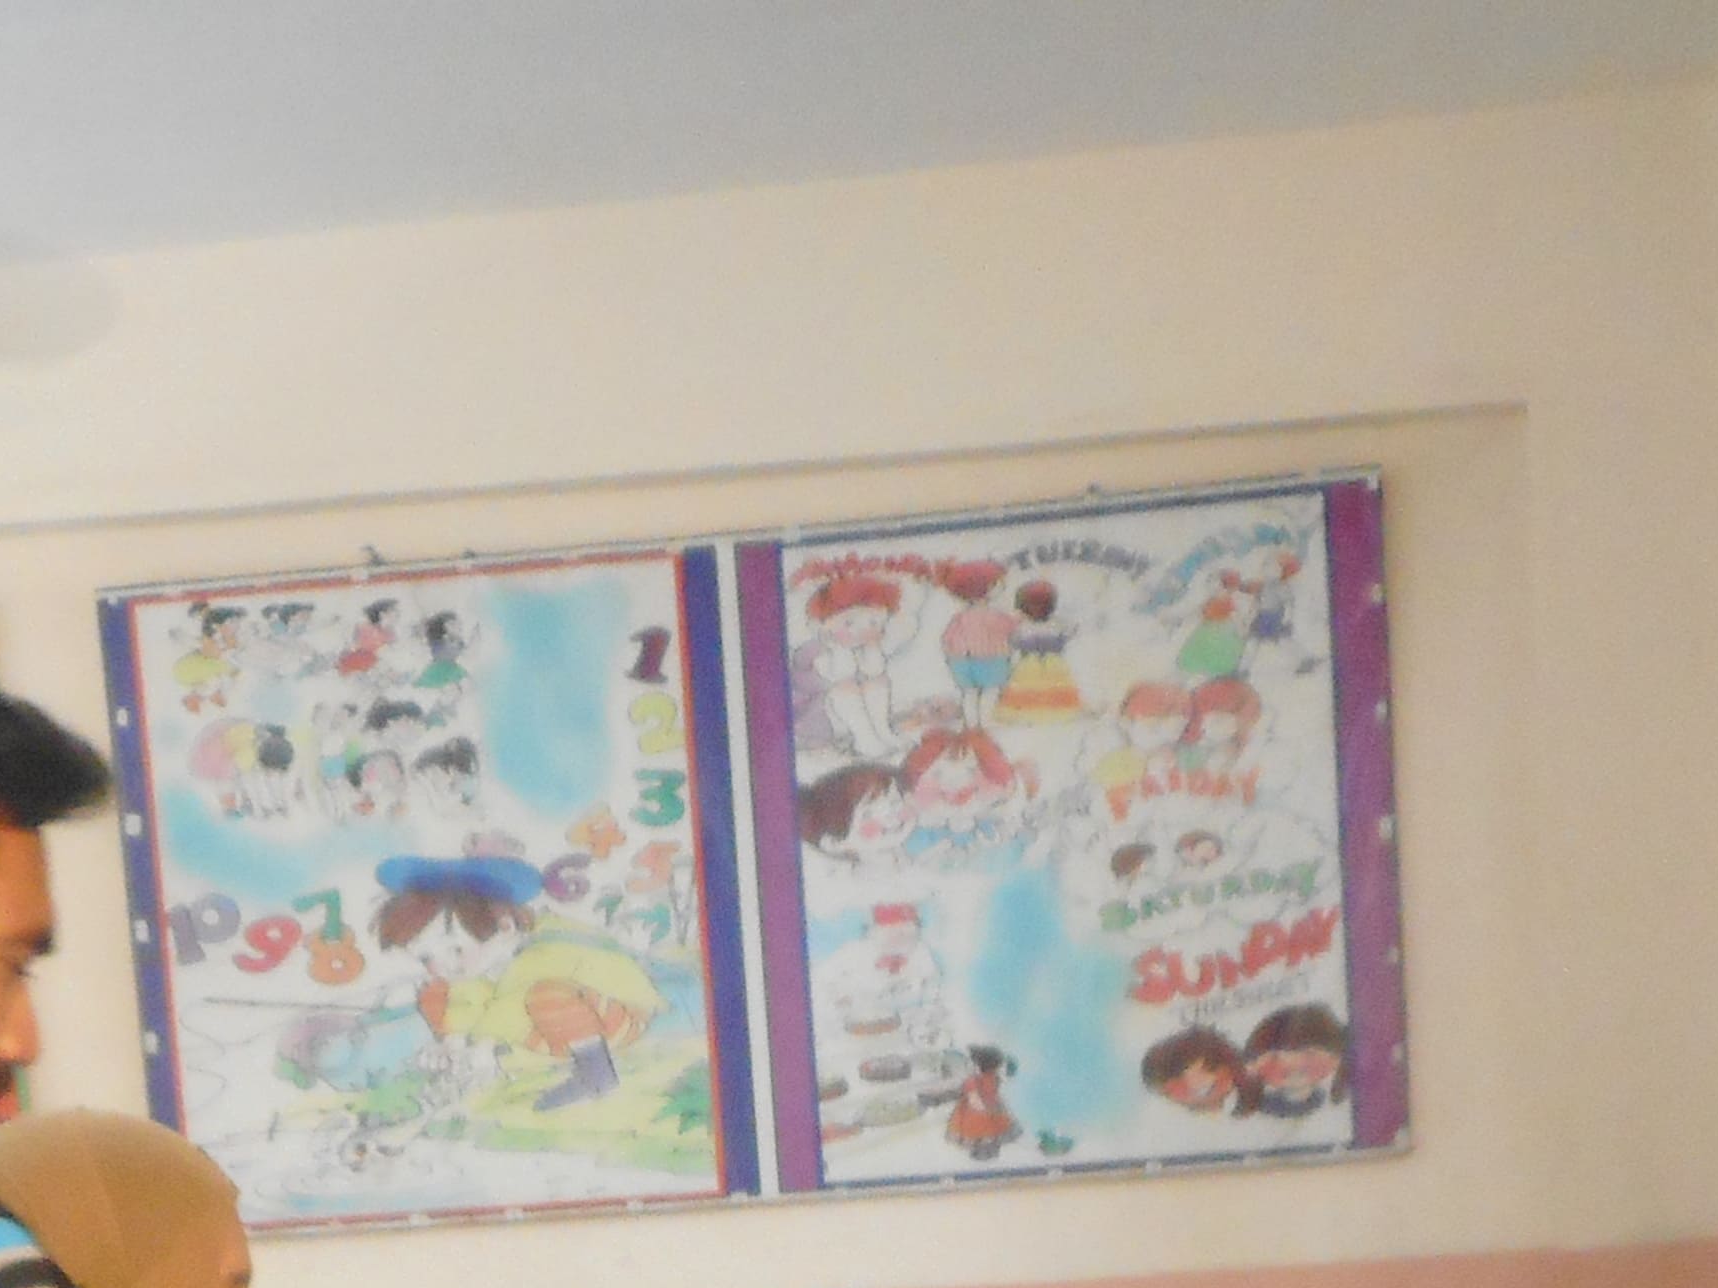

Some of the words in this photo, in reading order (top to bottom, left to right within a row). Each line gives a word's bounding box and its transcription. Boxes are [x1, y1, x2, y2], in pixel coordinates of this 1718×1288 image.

[626, 626, 671, 684] 1
[629, 692, 685, 755] 2
[628, 768, 685, 827] 3
[542, 853, 590, 902] 6
[626, 840, 681, 893] 5
[292, 888, 341, 940] 7
[233, 915, 303, 973] 9
[308, 924, 365, 985] 8
[1129, 906, 1340, 1006] SUNDAY
